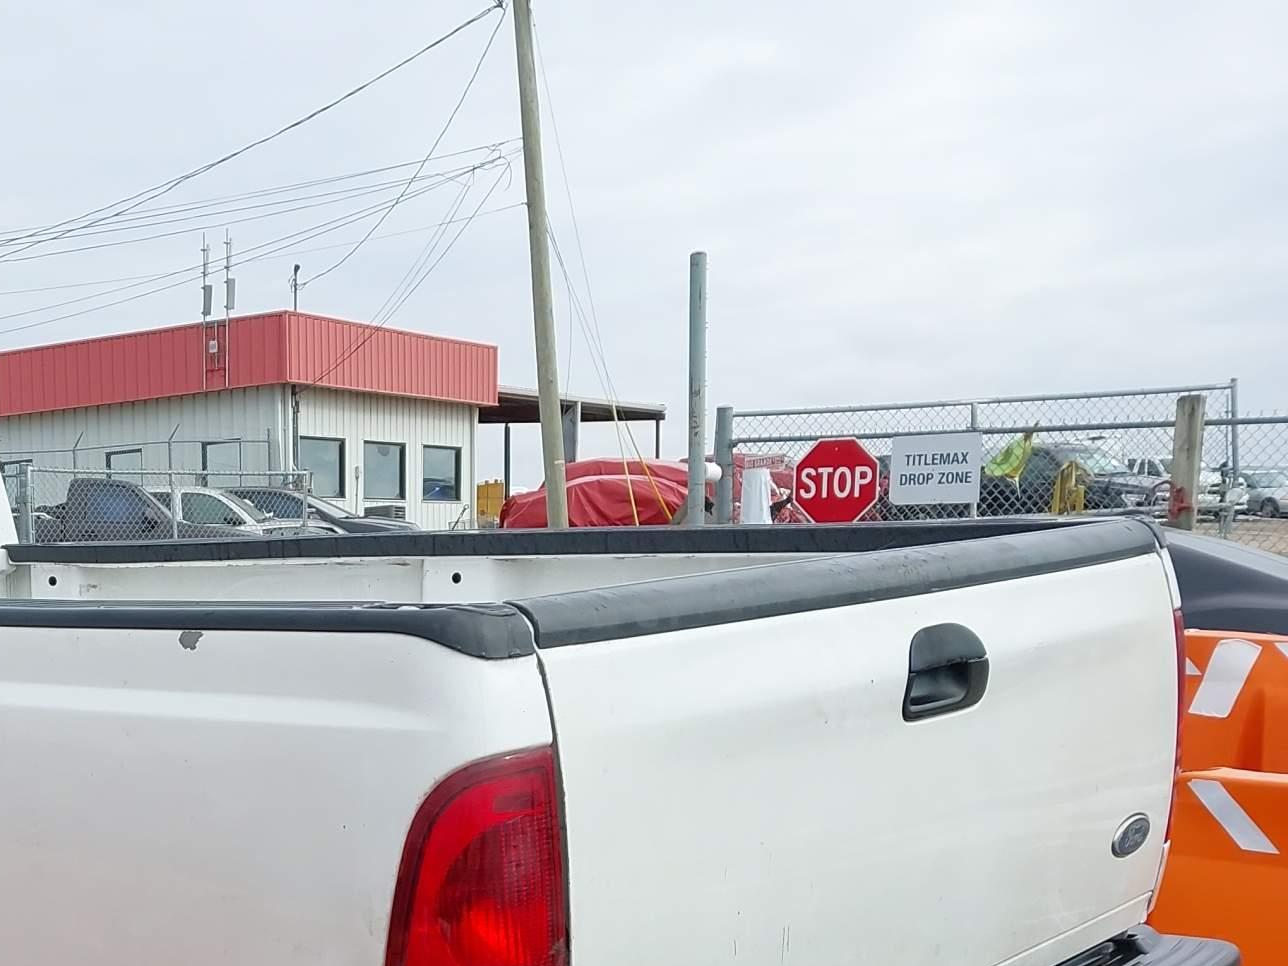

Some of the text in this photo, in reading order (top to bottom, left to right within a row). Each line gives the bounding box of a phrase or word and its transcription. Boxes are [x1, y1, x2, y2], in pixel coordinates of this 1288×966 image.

[905, 452, 969, 466] TITLEMAX
[799, 466, 873, 499] STOP
[899, 471, 973, 486] DROP ZONE
